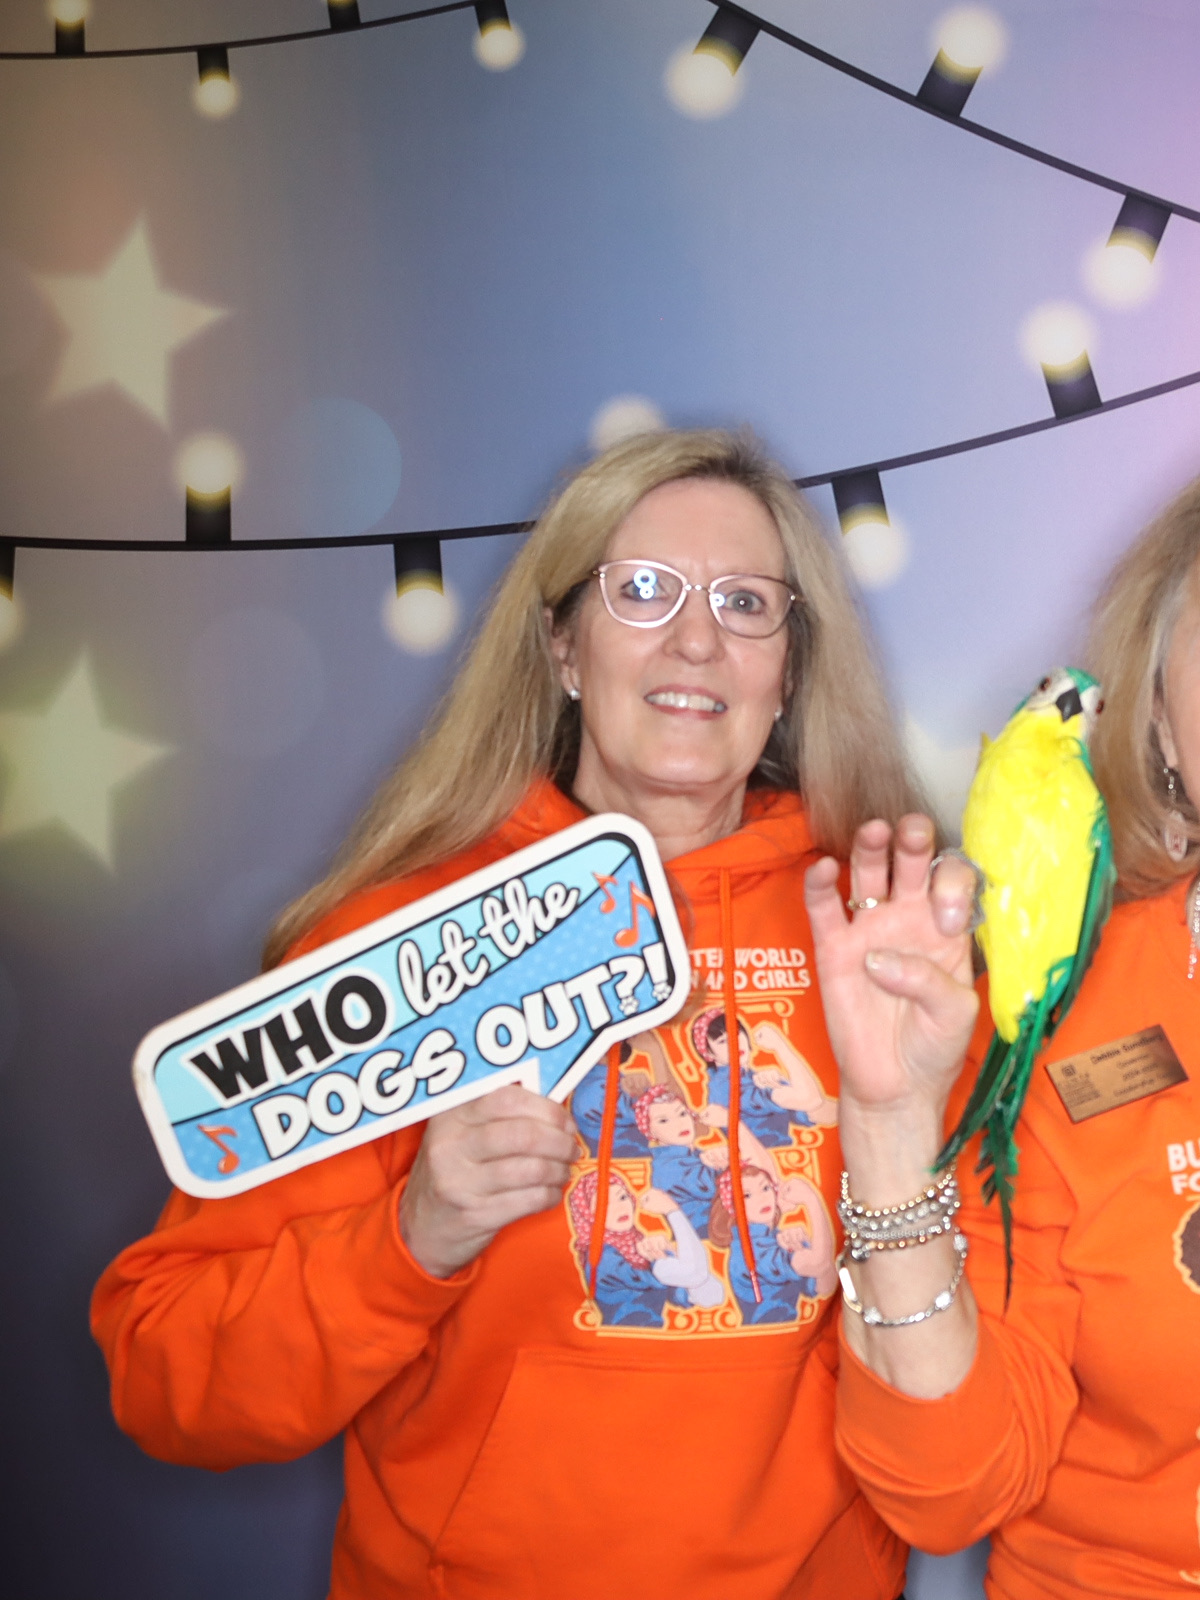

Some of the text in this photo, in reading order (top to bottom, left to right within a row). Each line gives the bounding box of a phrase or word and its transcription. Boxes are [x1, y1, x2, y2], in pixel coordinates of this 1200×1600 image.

[190, 877, 580, 1101] WHO let the
[734, 947, 806, 968] WORLD
[752, 969, 811, 990] GIRLS
[251, 942, 672, 1160] DOGS OUT?!
